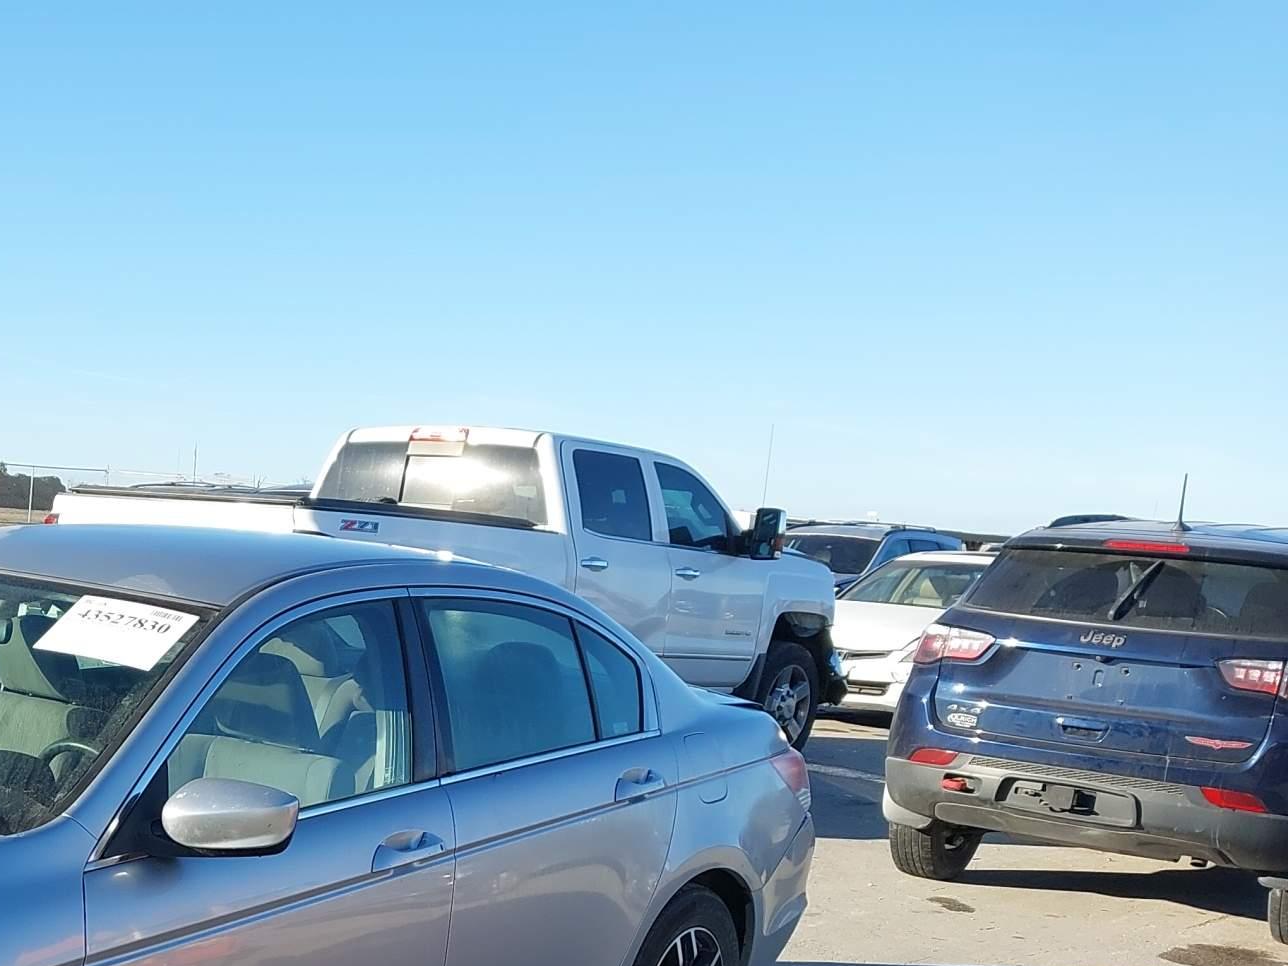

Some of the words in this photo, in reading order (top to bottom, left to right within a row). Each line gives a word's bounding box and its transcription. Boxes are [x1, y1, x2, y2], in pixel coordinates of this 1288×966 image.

[339, 518, 380, 534] Z71
[78, 608, 172, 634] 43527830
[1079, 629, 1127, 648] Jeep
